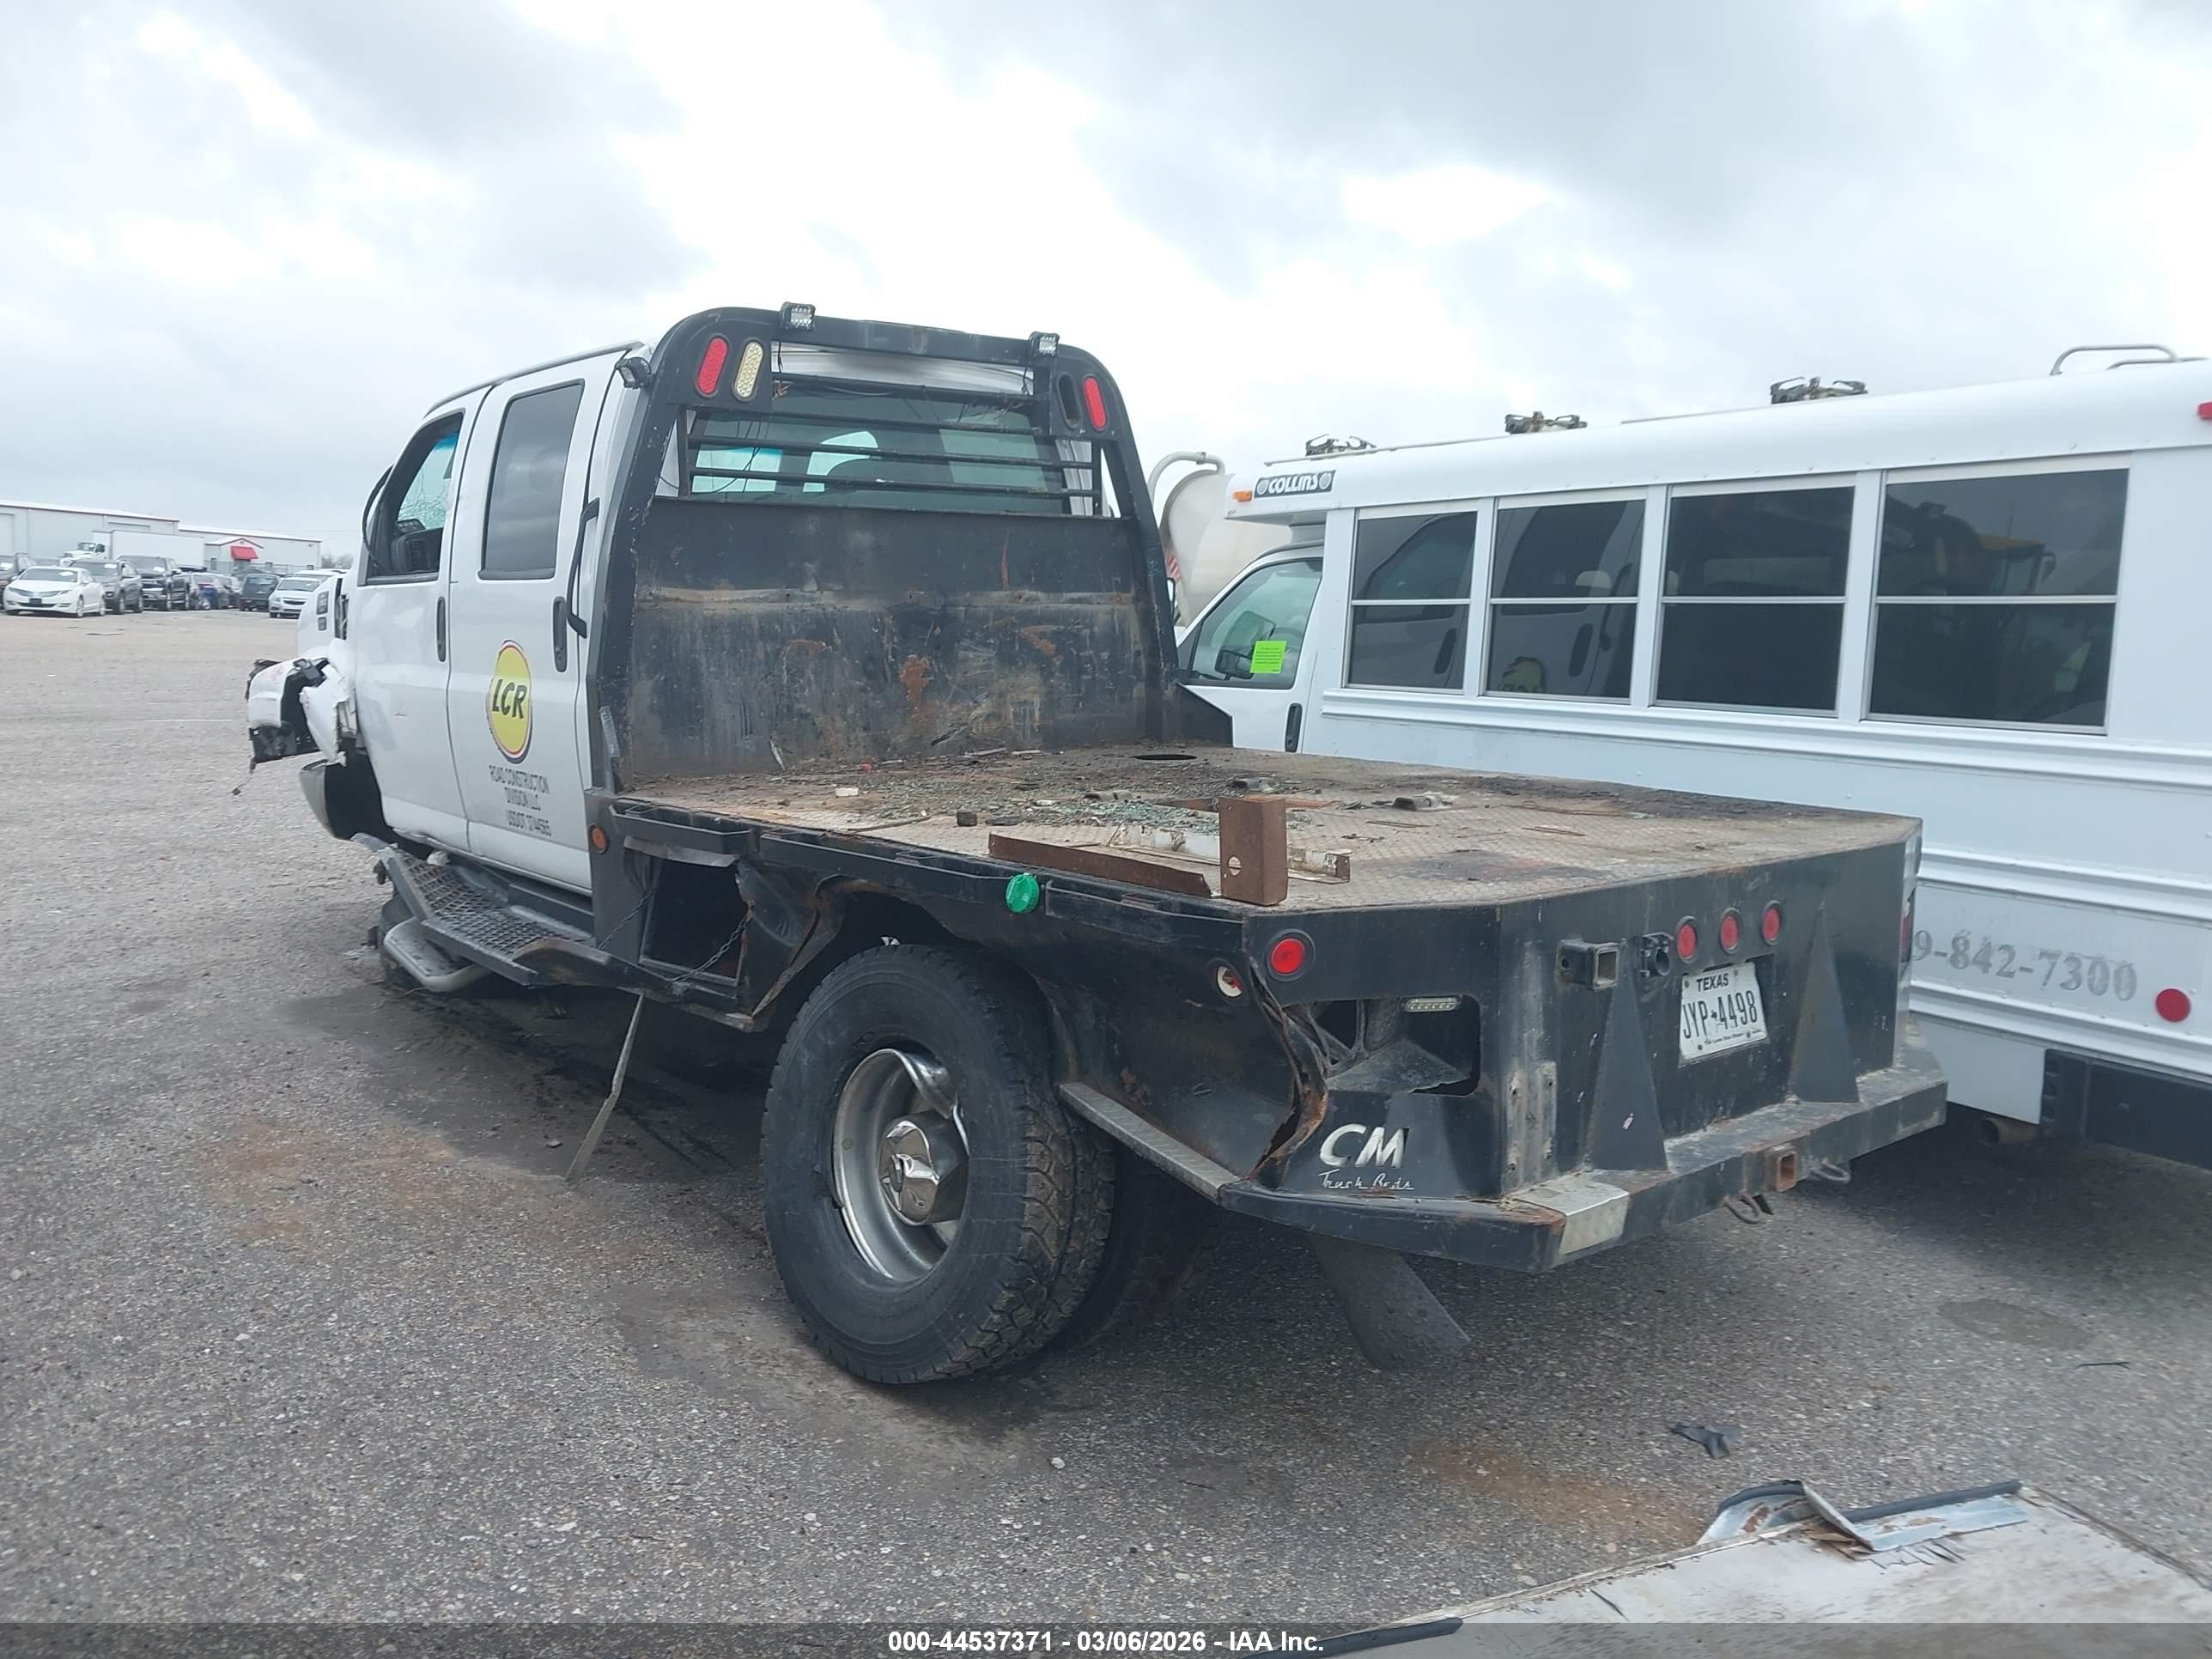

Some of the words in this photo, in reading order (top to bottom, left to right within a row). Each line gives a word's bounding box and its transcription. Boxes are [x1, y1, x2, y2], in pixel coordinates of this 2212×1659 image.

[1268, 473, 1318, 494] COLLINS
[491, 678, 527, 720] LCR
[505, 768, 550, 795] CONSTRUCTION
[1696, 972, 1729, 993] TEXAS
[1320, 1123, 1411, 1169] CM
